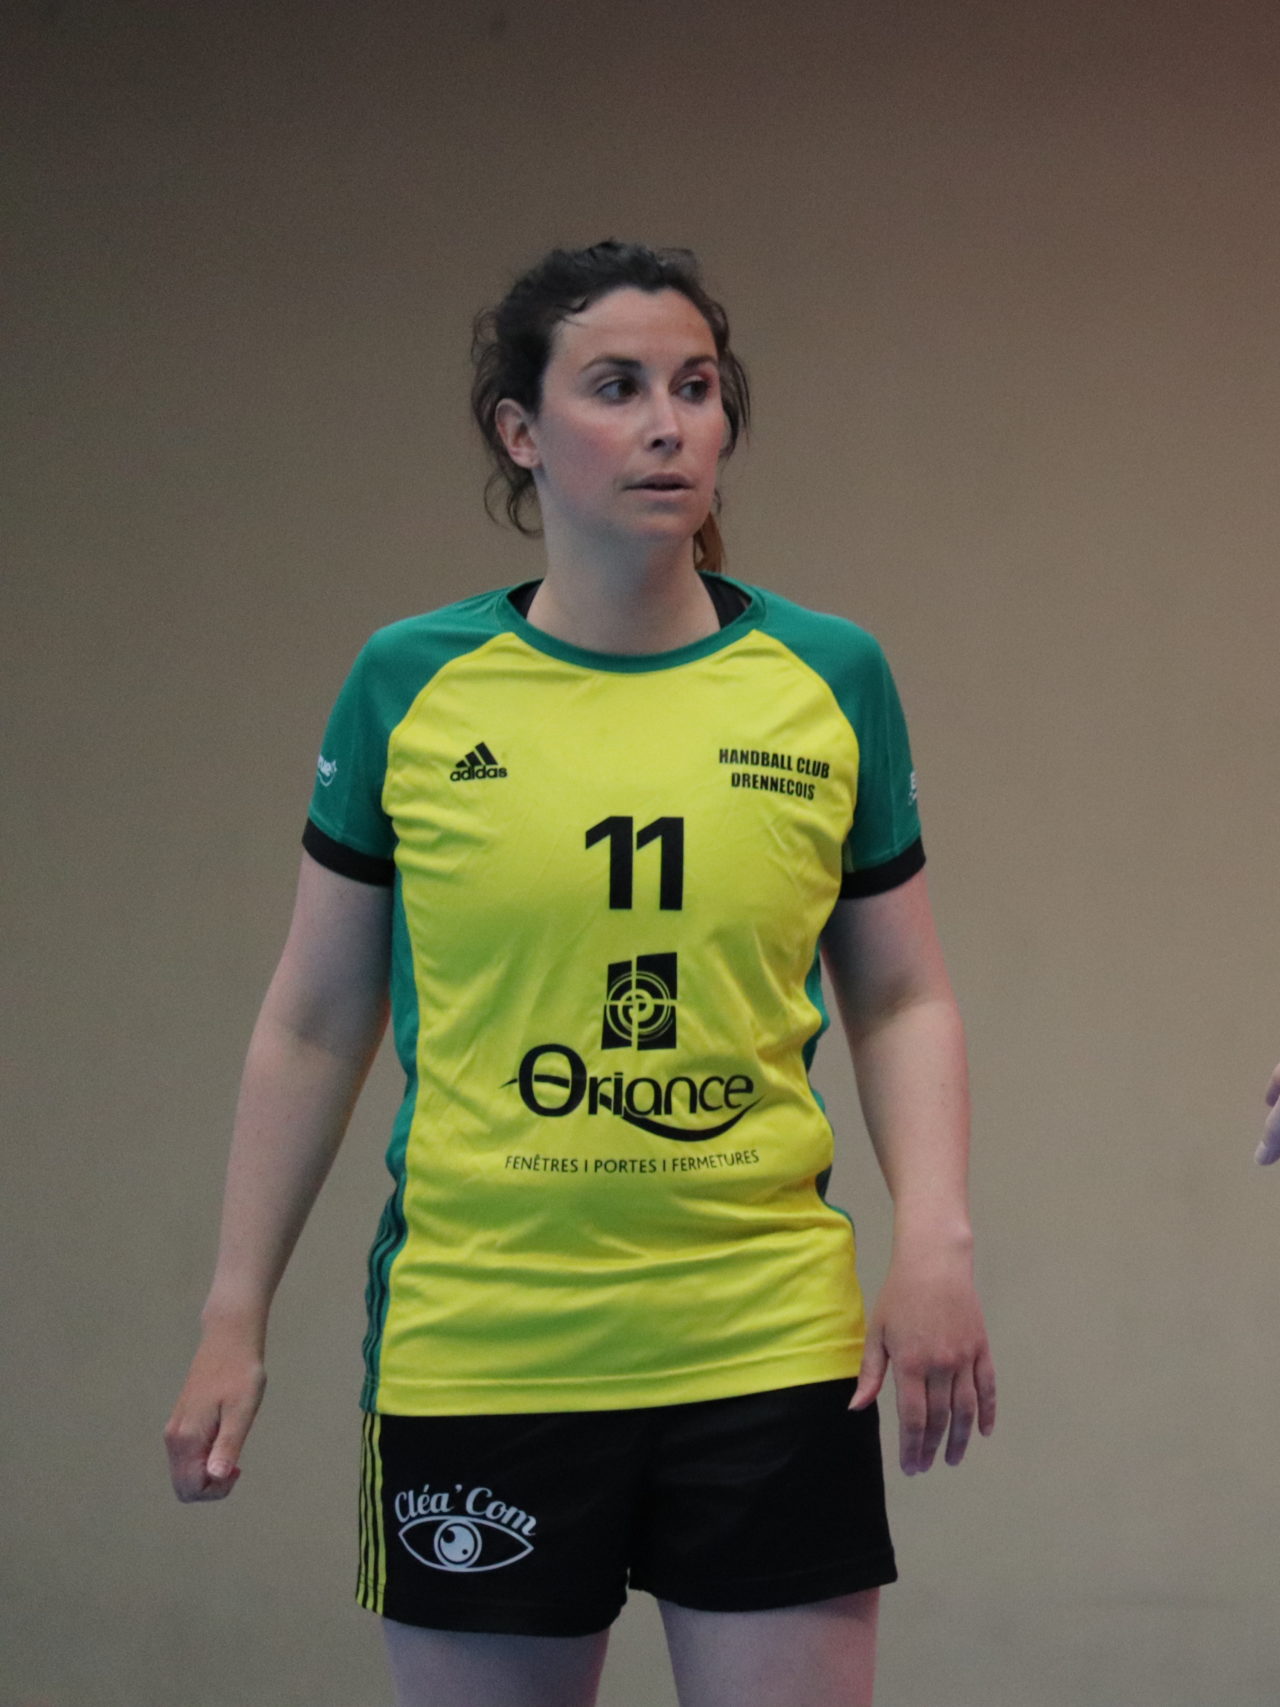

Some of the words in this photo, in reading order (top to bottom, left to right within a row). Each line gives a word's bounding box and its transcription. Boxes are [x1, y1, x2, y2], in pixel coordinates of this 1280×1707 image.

[450, 765, 508, 782] adidas
[719, 749, 793, 771] HANDBALL
[796, 757, 830, 779] CLUB
[731, 772, 816, 800] DRENNECOIS
[585, 816, 684, 911] 11
[516, 1043, 756, 1119] Oriance
[505, 1154, 578, 1174] FENÊTRES
[594, 1158, 657, 1173] PORTES
[672, 1149, 760, 1172] FERMETURES
